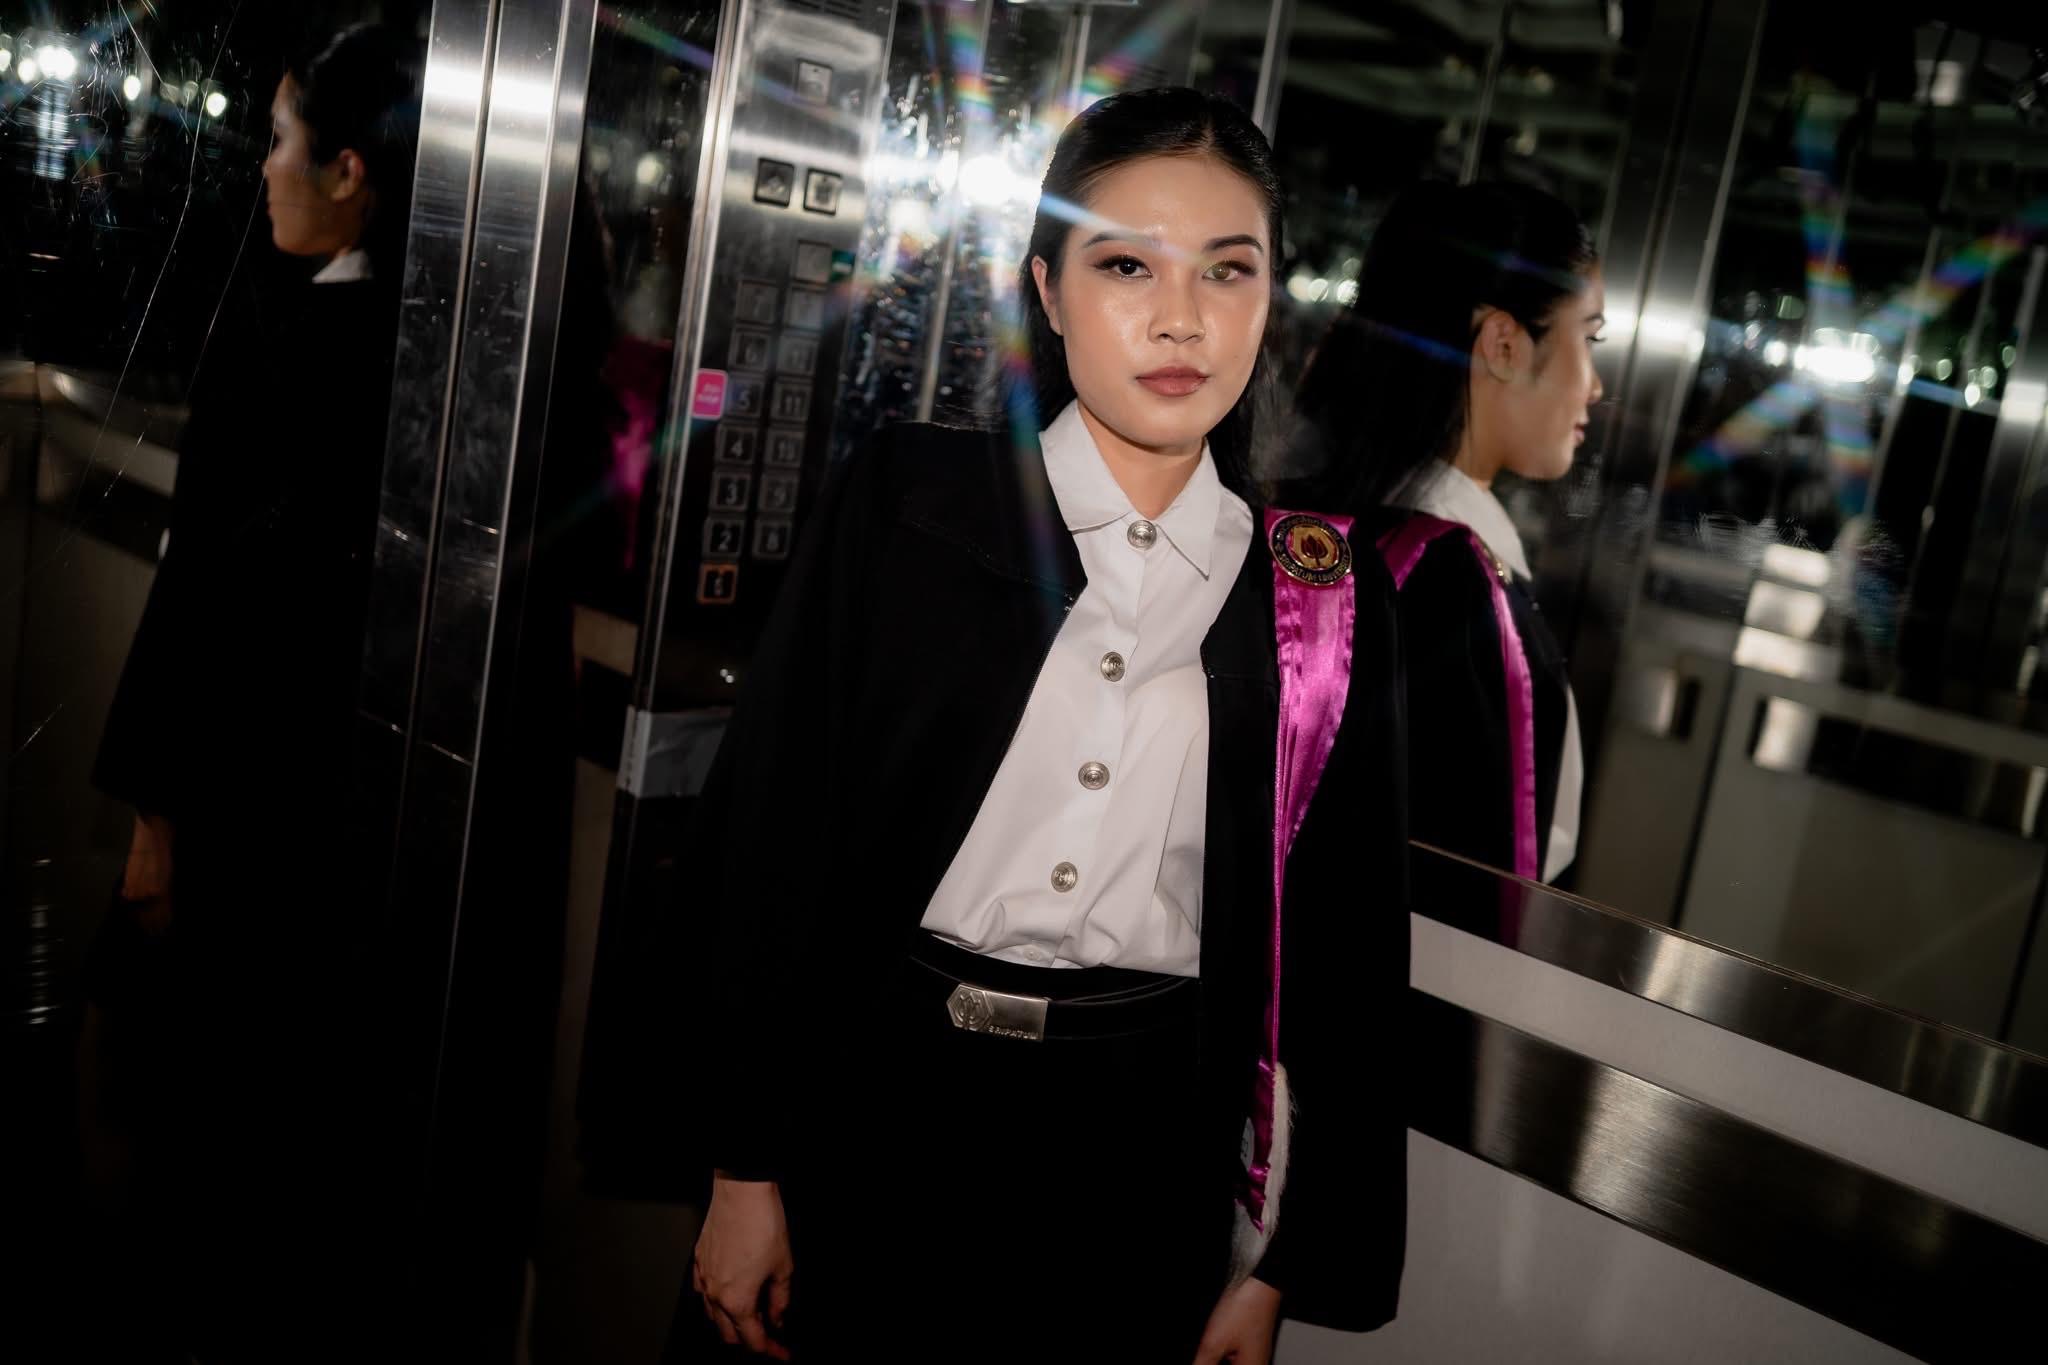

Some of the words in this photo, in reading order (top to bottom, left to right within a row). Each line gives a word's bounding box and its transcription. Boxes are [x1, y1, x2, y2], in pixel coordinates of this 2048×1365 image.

[739, 388, 751, 411] 5
[730, 440, 743, 457] 4
[725, 482, 738, 505] 3
[718, 529, 732, 551] 2
